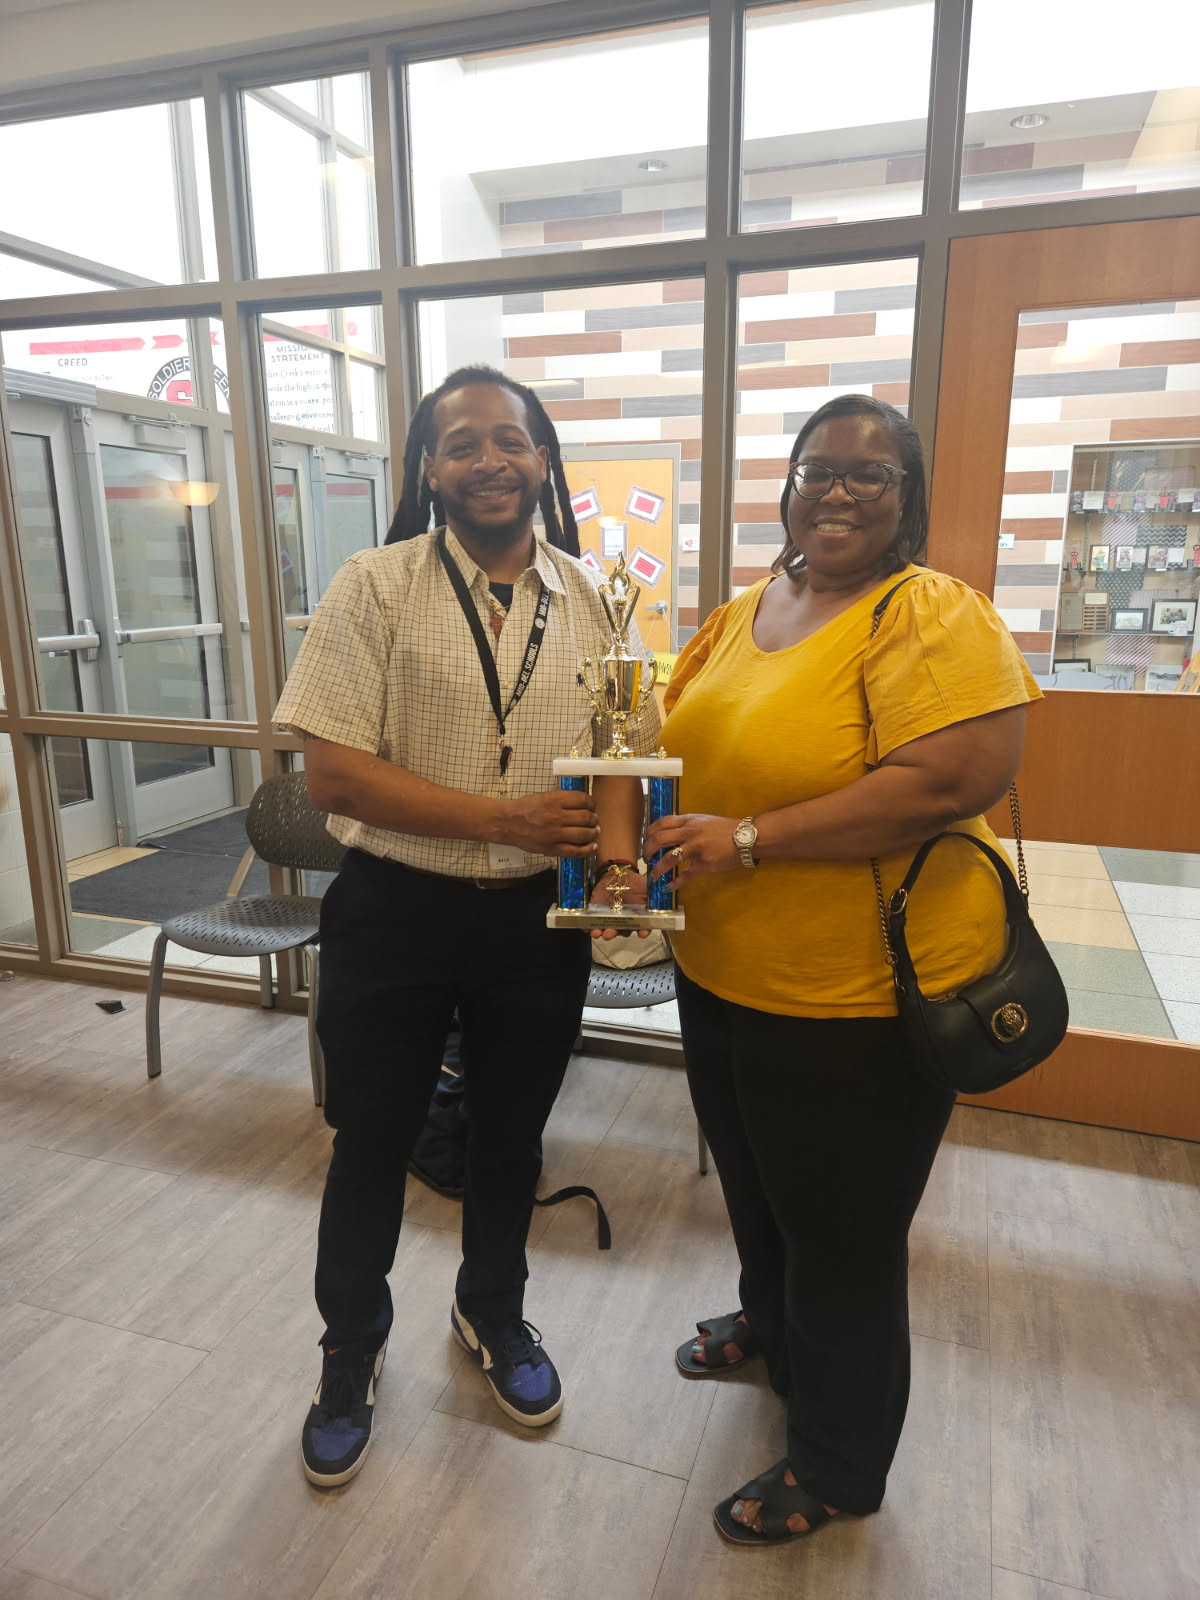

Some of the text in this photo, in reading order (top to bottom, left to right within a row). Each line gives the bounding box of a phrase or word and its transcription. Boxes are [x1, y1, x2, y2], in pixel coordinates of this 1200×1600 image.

[276, 344, 312, 352] MISSIO
[57, 357, 88, 367] CREED
[271, 352, 324, 363] STATEMENT
[148, 357, 192, 400] SOLDIER
[515, 642, 540, 697] MID-DEL SCHOOLS
